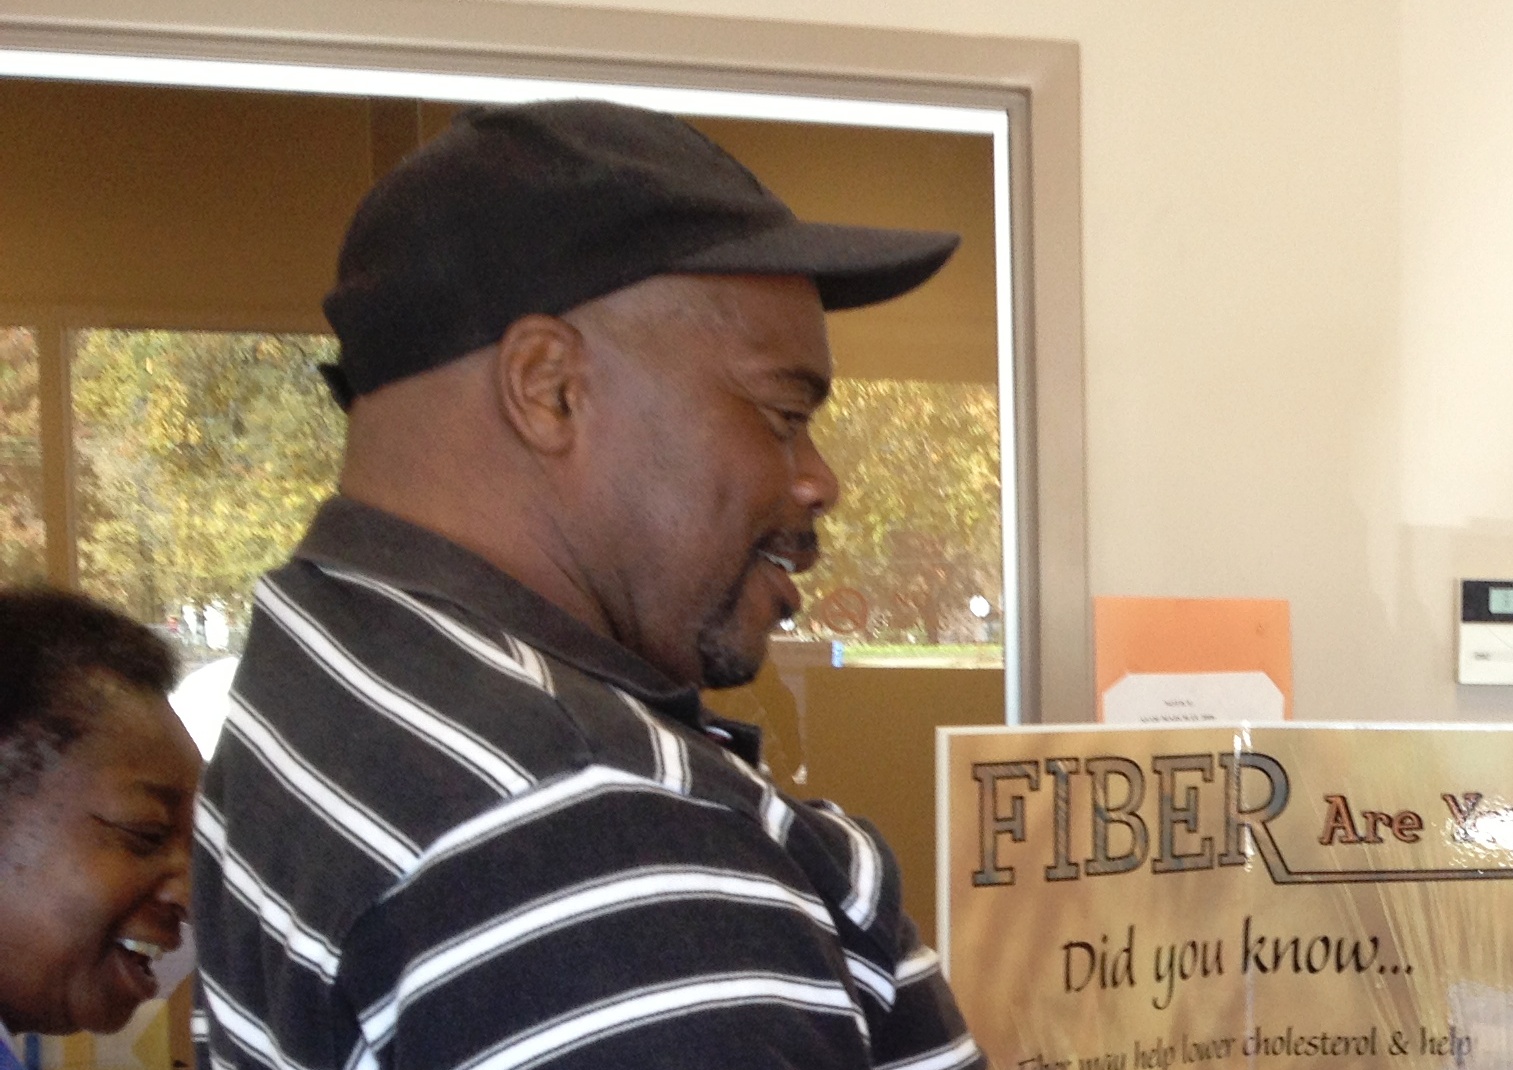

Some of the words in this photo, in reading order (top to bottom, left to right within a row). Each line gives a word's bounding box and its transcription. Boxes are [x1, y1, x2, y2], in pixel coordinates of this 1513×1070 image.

[972, 752, 1290, 887] FIBER
[1319, 794, 1424, 846] Are
[1061, 923, 1137, 993] Did
[1151, 937, 1224, 1011] you
[1241, 914, 1415, 976] know...
[1181, 1032, 1237, 1065] lower
[1242, 1025, 1378, 1057] cholesterol
[1388, 1030, 1410, 1056] &
[1419, 1025, 1472, 1067] help
